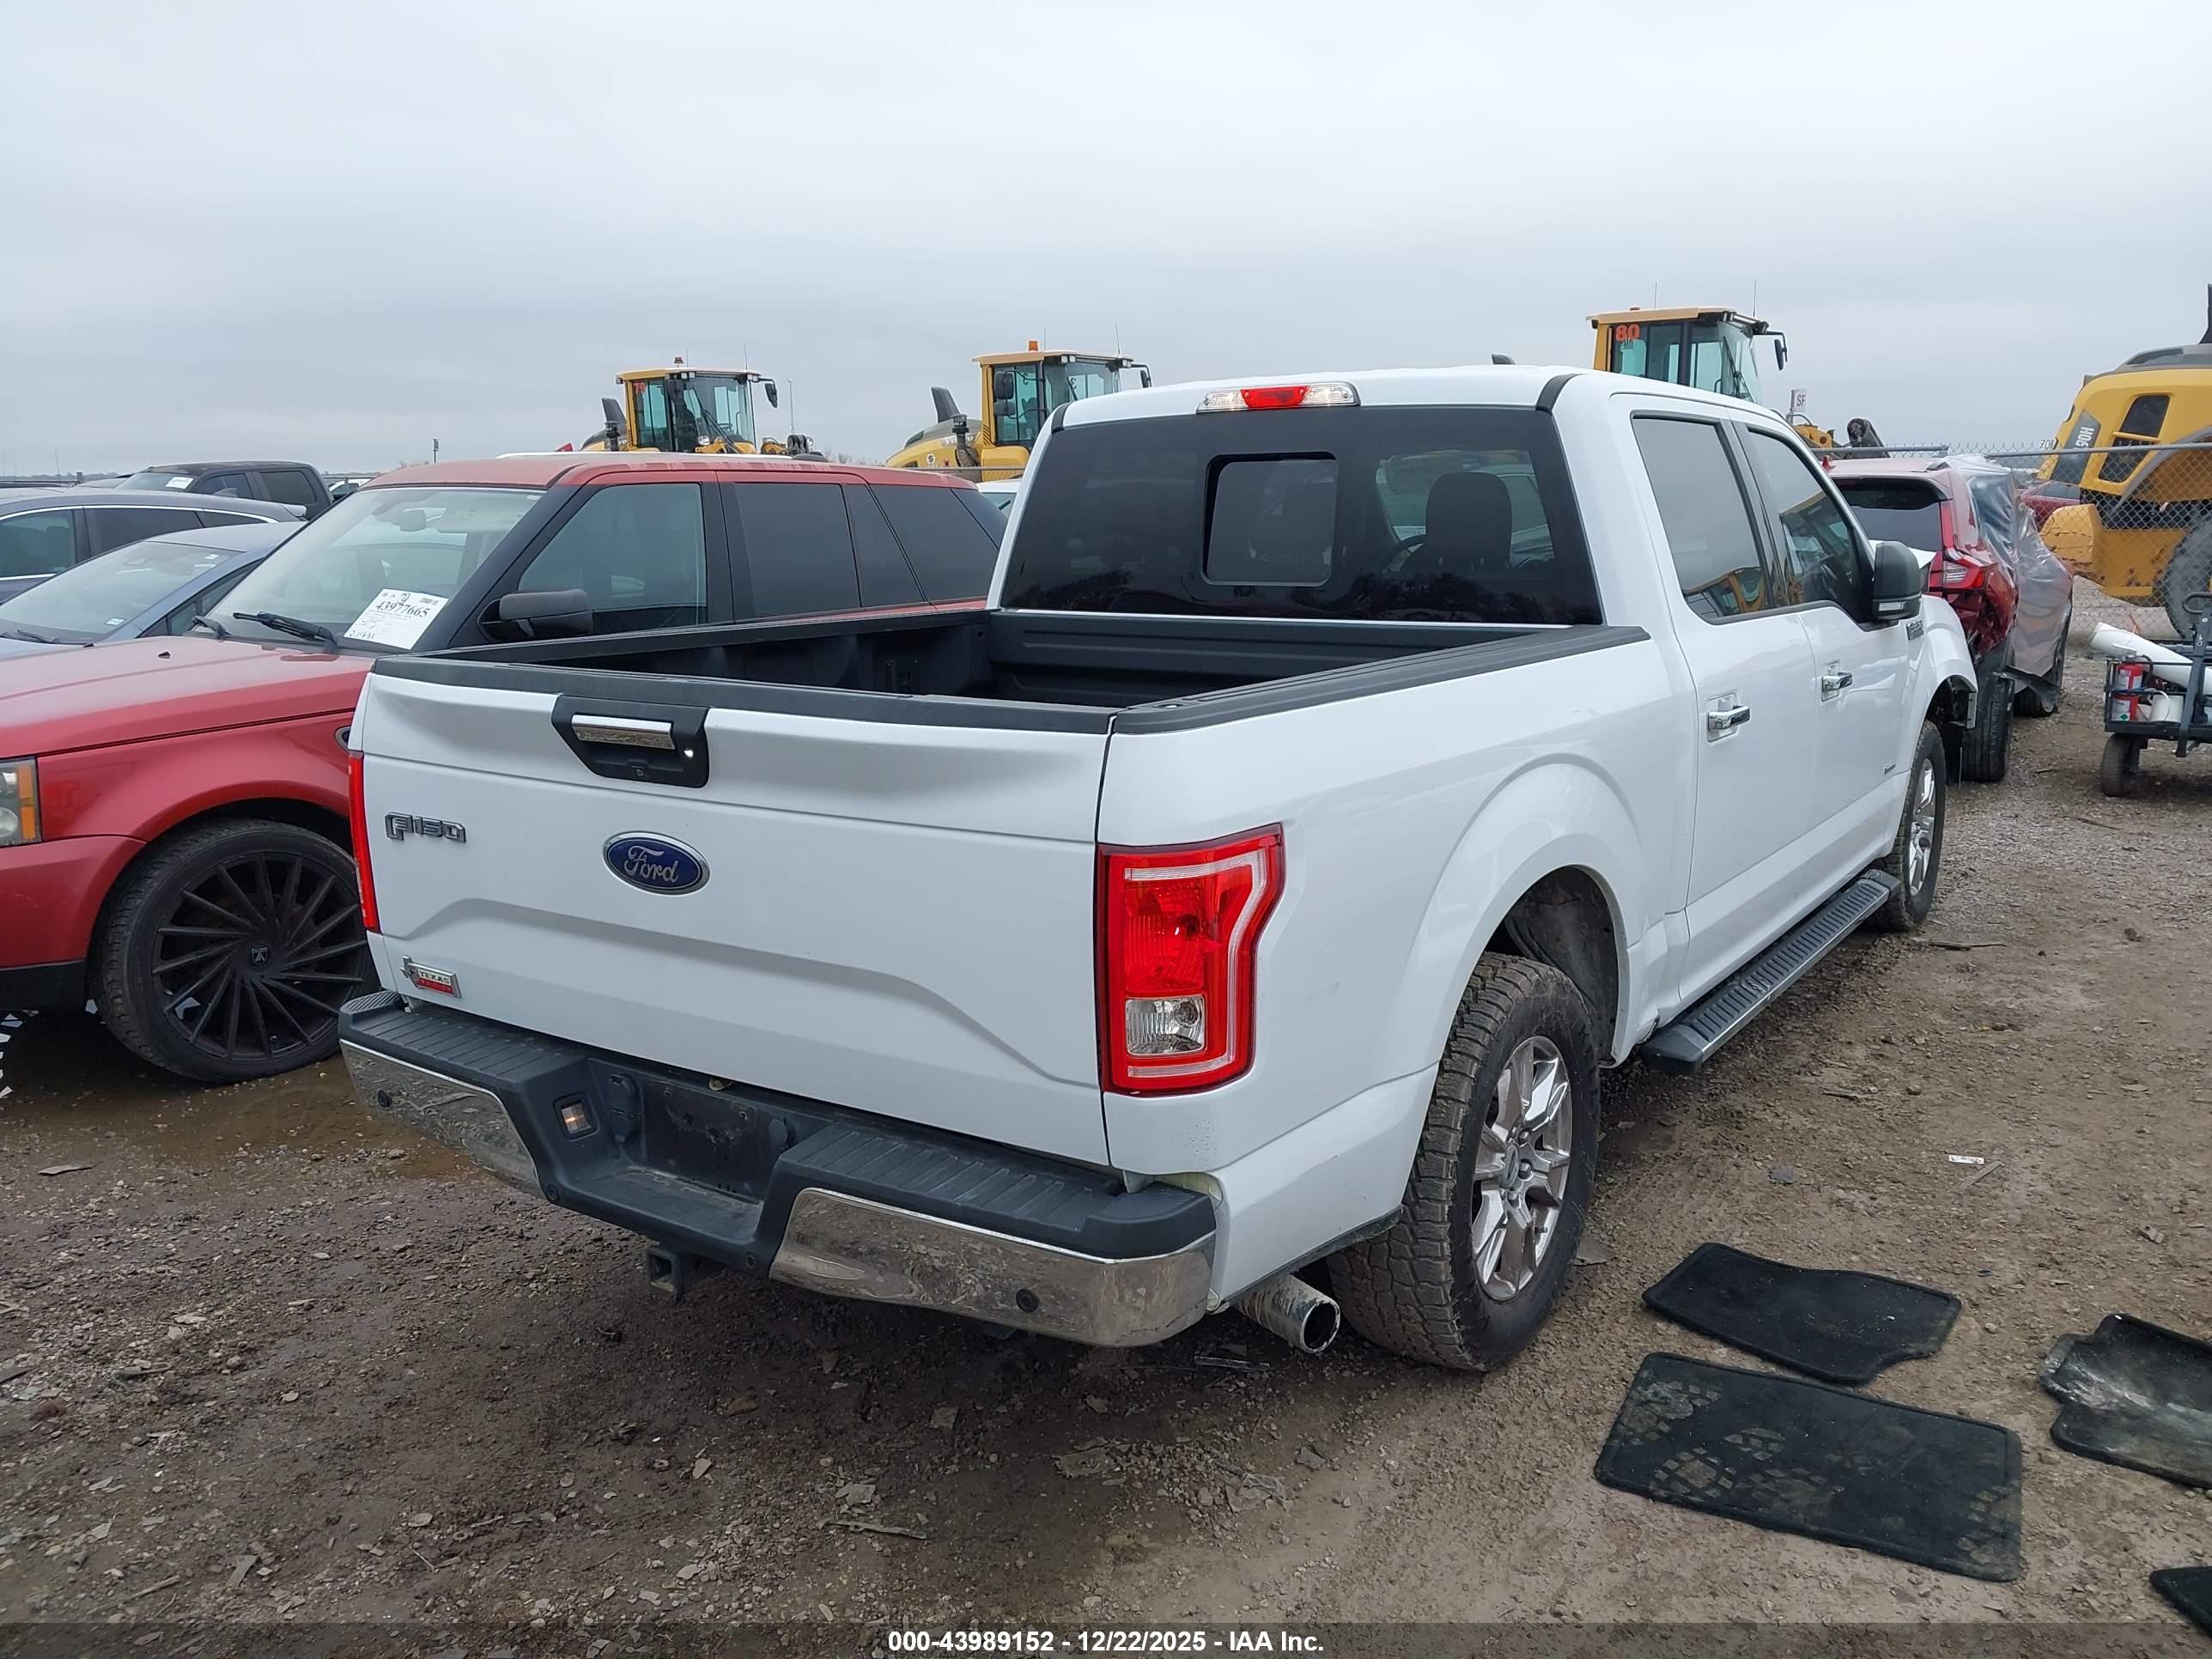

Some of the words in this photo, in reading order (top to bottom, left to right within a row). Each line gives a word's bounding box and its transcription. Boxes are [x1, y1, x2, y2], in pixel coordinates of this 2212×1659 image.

[1616, 324, 1640, 341] 80
[2074, 427, 2094, 450] 90H
[375, 600, 430, 617] 43977665
[623, 845, 679, 883] Ford
[418, 970, 450, 985] TEXAS
